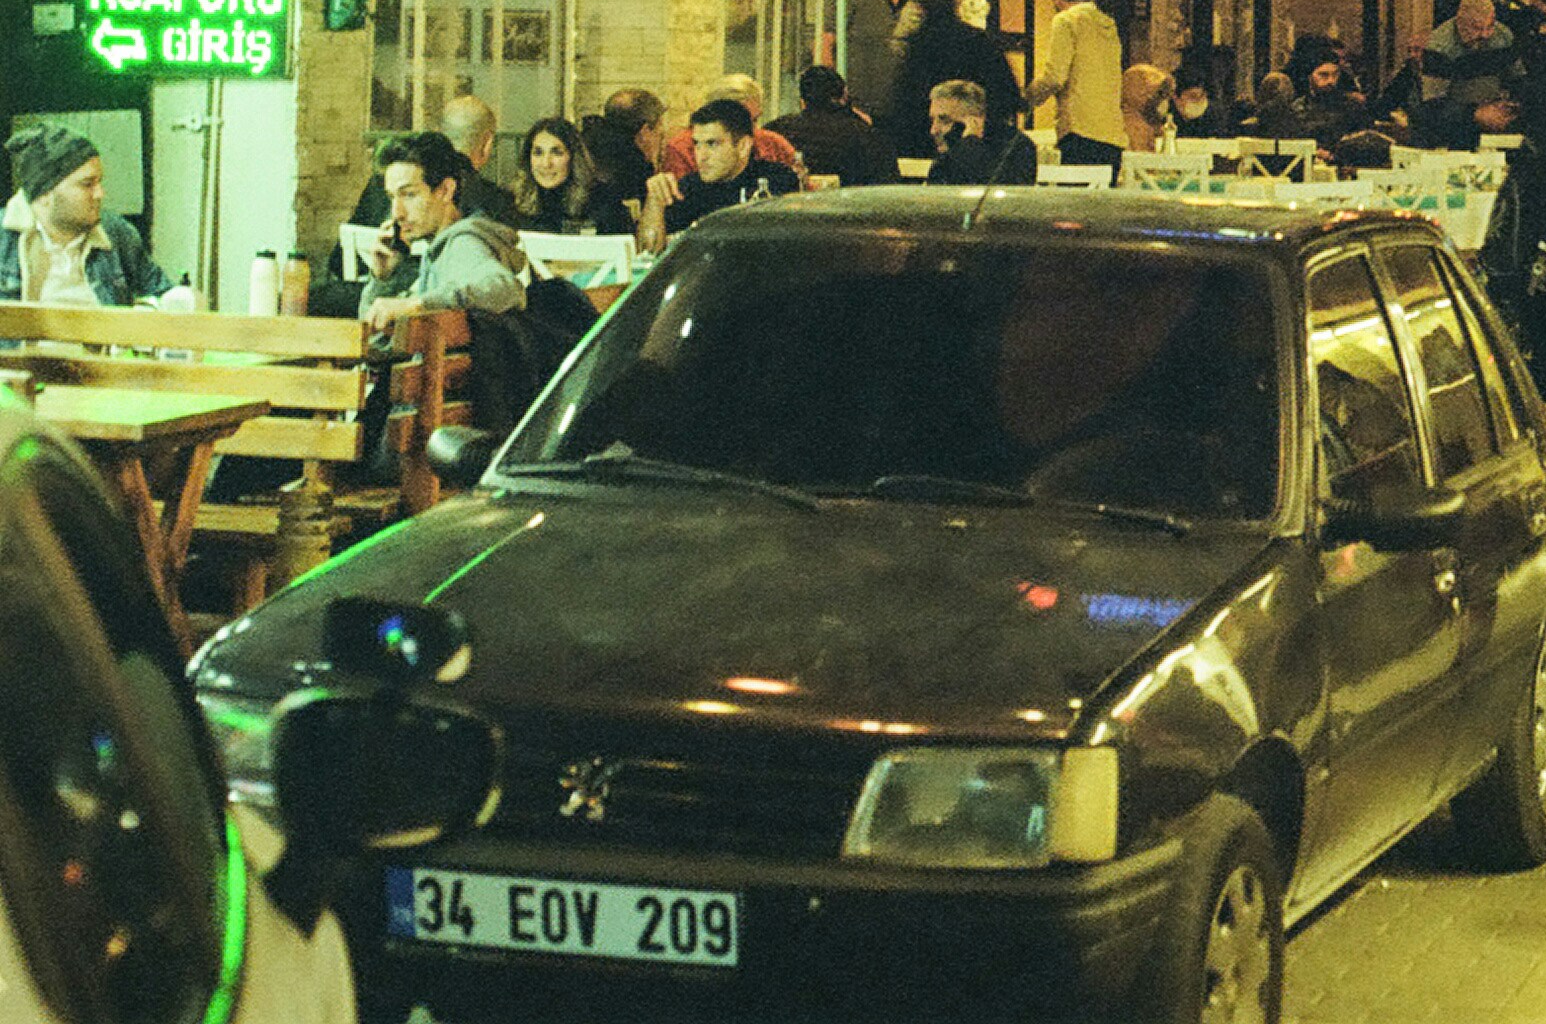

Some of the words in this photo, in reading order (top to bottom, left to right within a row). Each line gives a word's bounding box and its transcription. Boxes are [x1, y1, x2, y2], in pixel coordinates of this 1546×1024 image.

[161, 17, 273, 75] GİRİŞ
[417, 875, 476, 937] 34
[507, 886, 599, 946] EOV
[637, 895, 734, 957] 209
